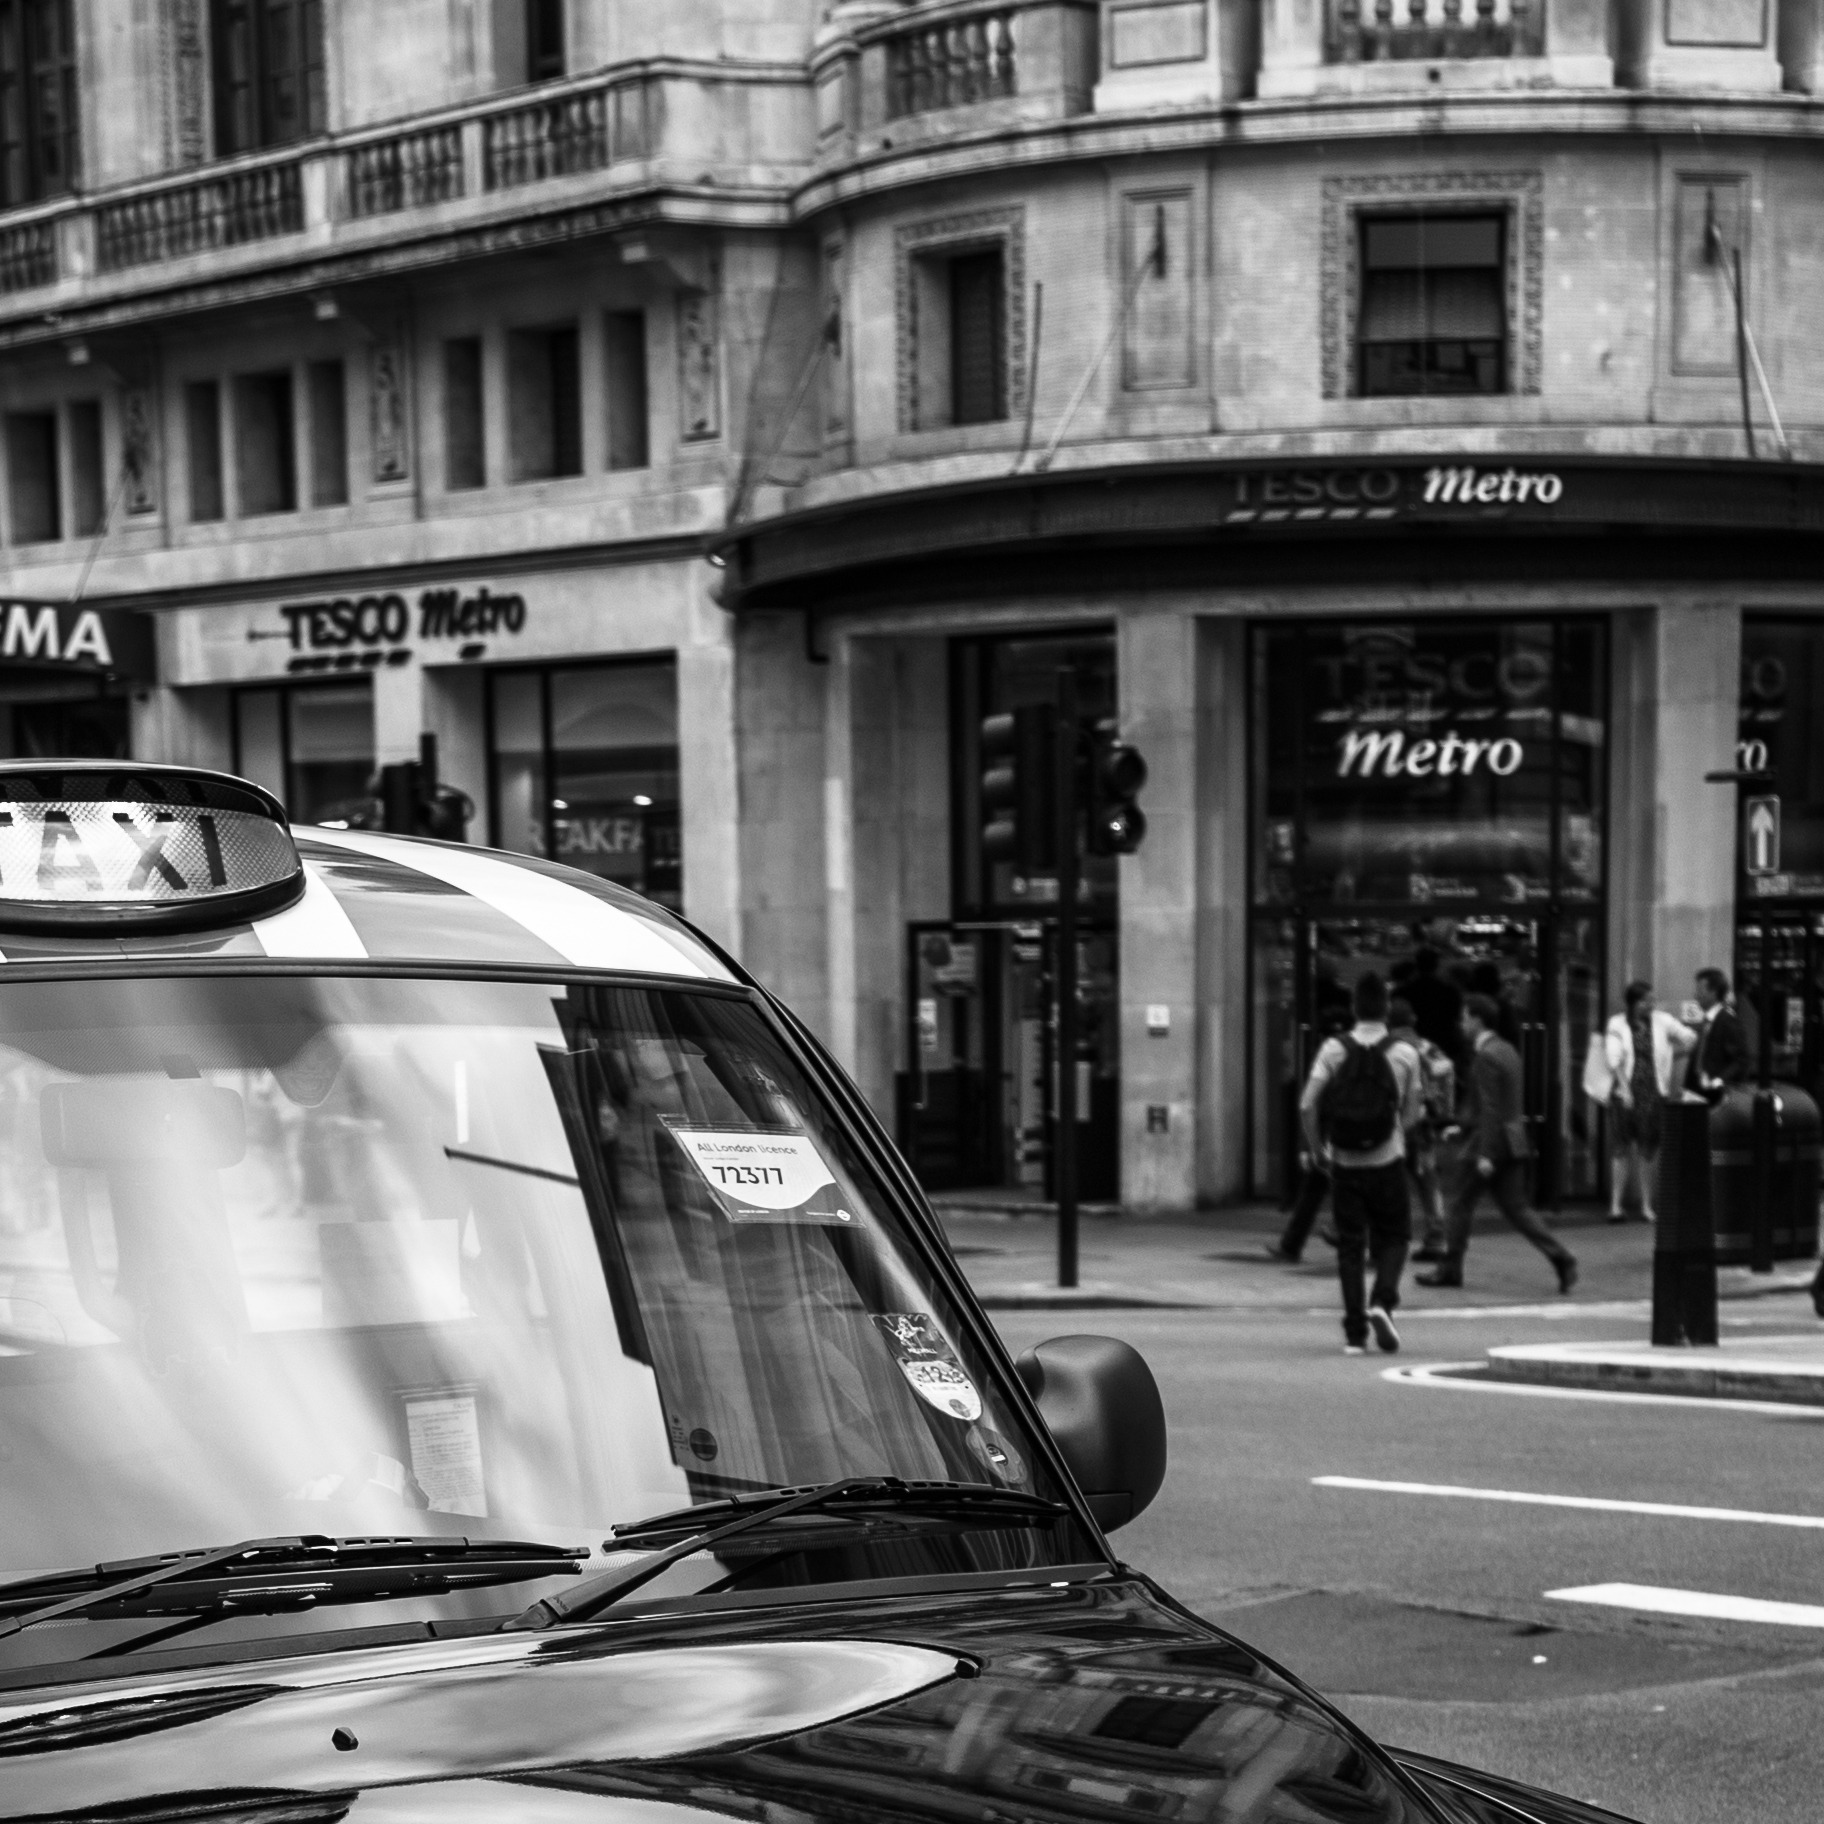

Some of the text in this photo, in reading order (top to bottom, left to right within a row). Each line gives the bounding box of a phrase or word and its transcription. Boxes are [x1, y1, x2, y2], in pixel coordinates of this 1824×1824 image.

[1228, 466, 1564, 504] TESCO Metro
[280, 588, 527, 648] TESCO Metro
[1308, 652, 1553, 699] TESCO
[1336, 730, 1524, 778] Metro
[697, 1143, 798, 1155] All London licence
[712, 1166, 784, 1185] 72377
